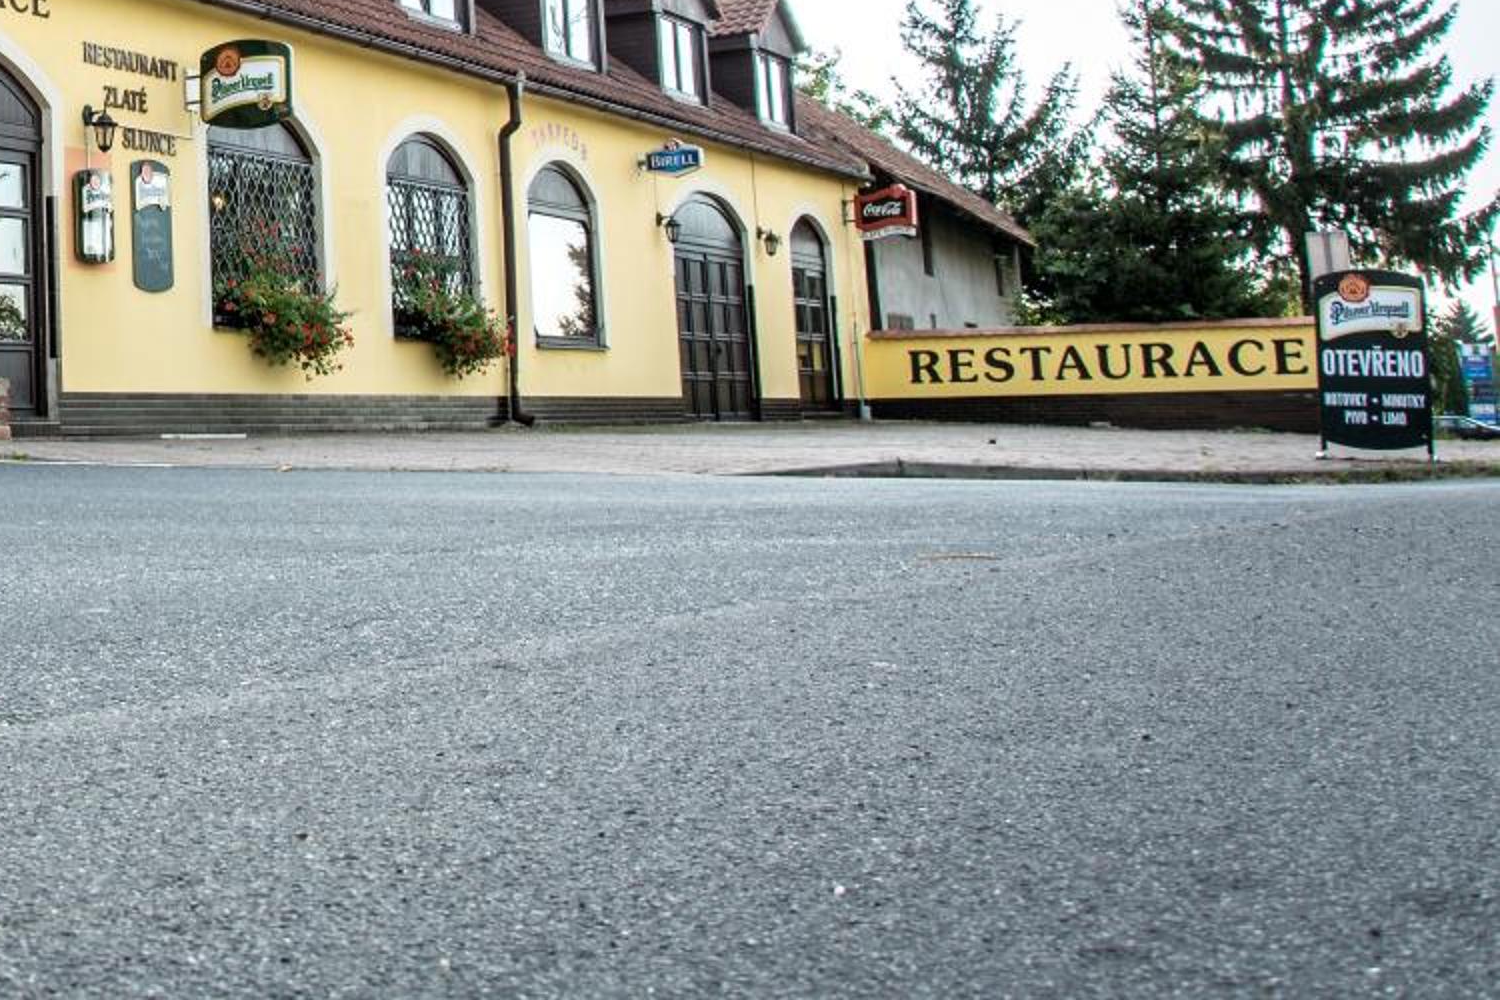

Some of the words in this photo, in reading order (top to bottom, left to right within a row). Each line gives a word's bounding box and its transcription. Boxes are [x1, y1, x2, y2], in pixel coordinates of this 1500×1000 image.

[82, 40, 179, 82] RESTAURANT
[102, 86, 148, 114] ZLATÉ
[121, 127, 177, 156] SLUNCE
[908, 338, 1310, 385] RESTAURACE
[1321, 345, 1426, 378] OTEVŘENO
